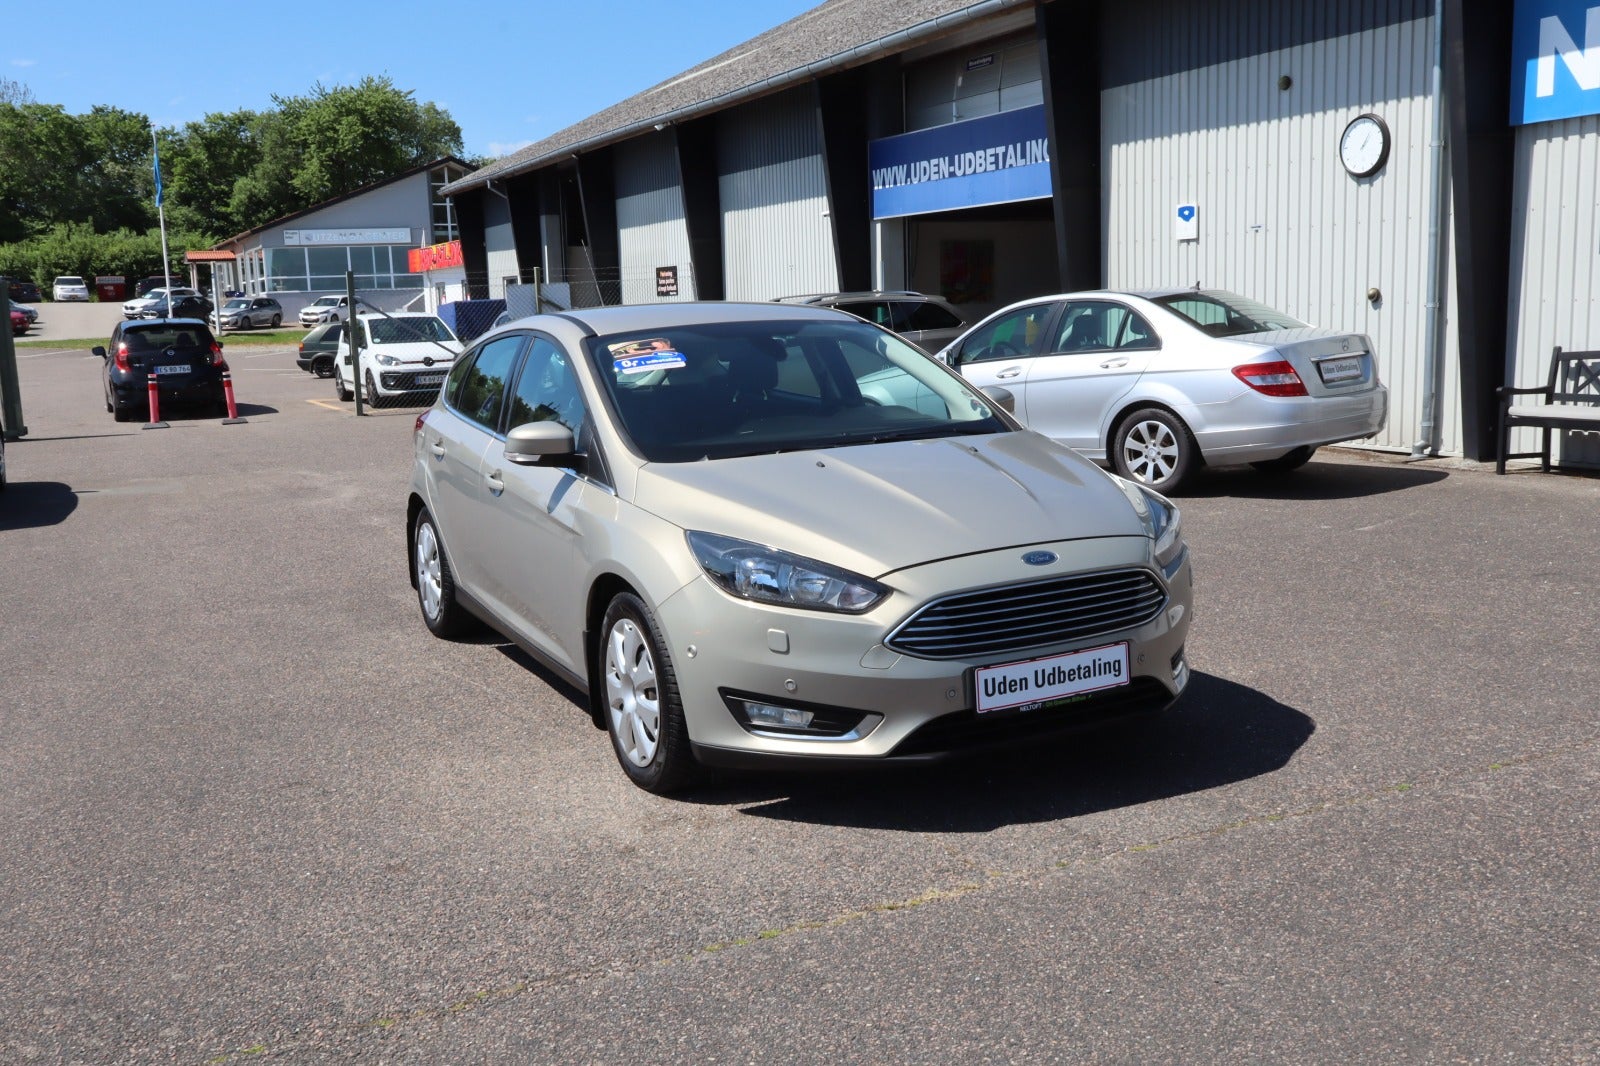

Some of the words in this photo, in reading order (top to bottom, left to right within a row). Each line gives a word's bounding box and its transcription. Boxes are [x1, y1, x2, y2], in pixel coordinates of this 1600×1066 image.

[1536, 6, 1600, 98] N
[984, 675, 1029, 698] Uden
[1033, 657, 1122, 688] Udbetaling
[1019, 702, 1043, 712] NELTOFT
